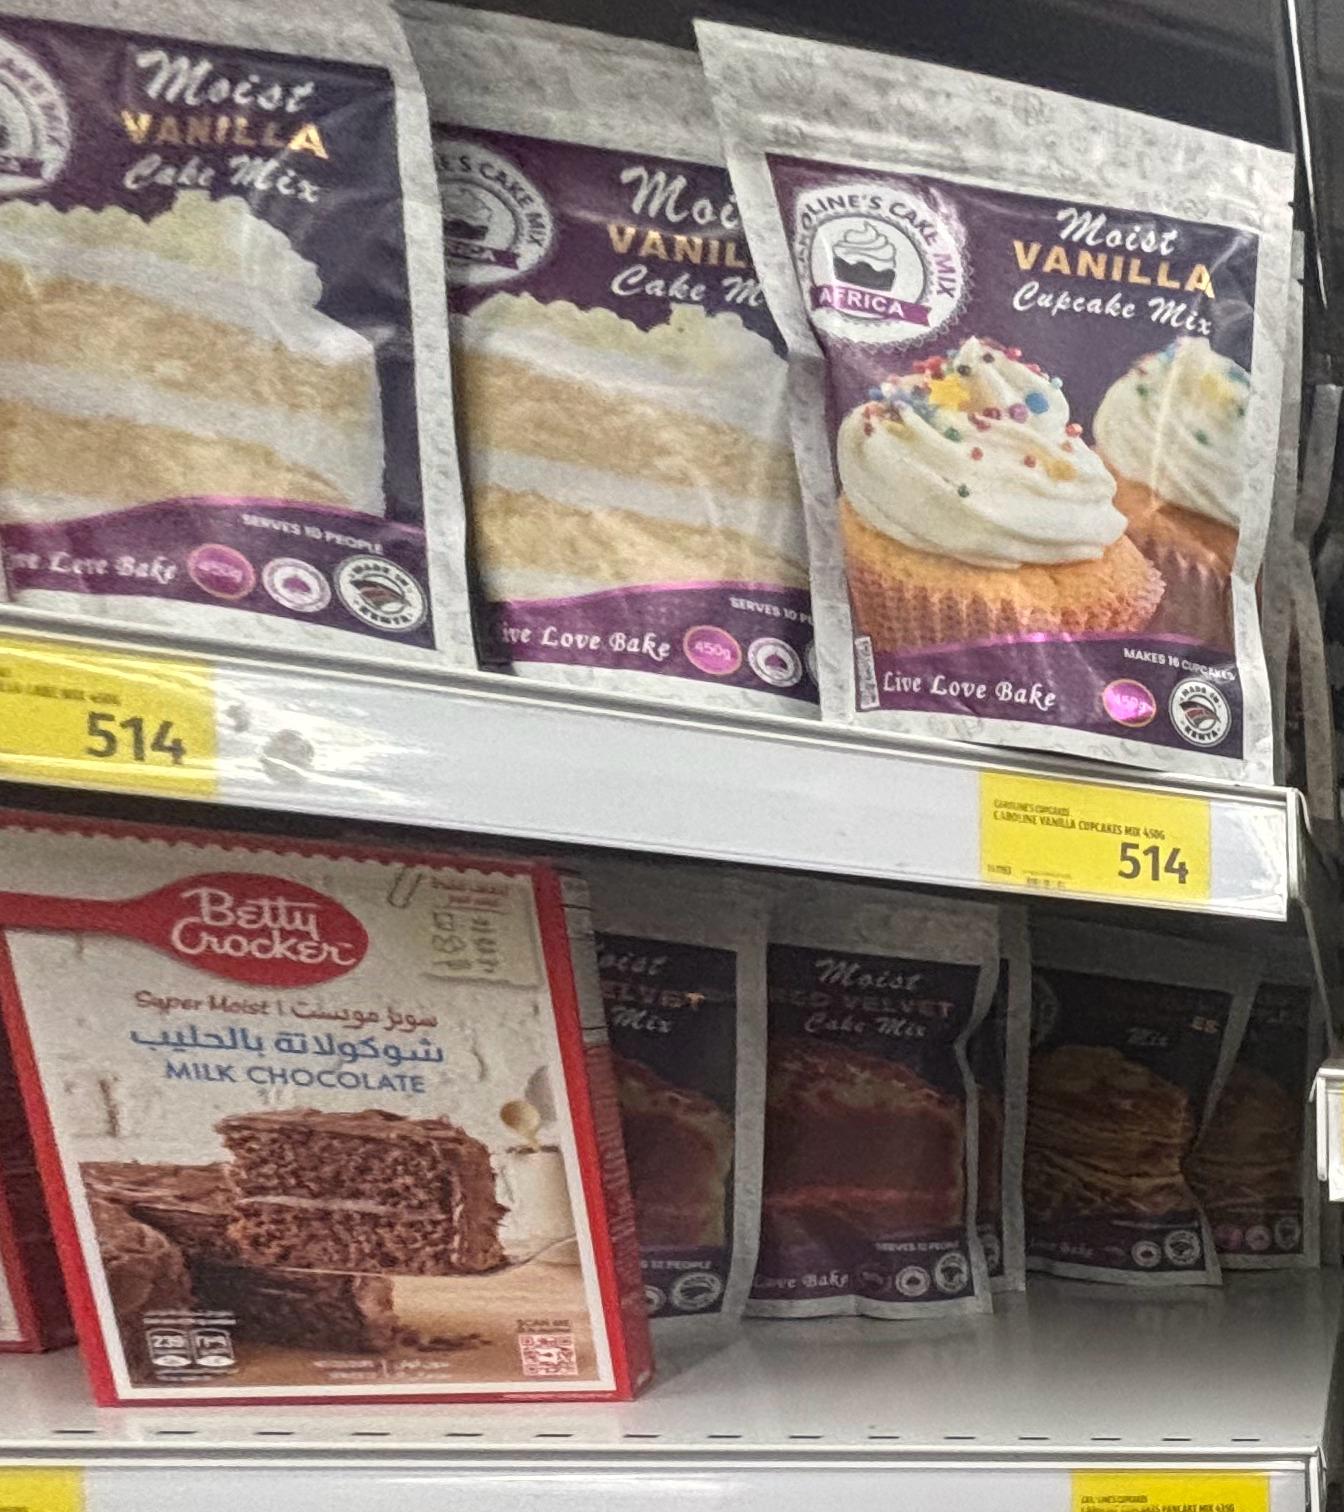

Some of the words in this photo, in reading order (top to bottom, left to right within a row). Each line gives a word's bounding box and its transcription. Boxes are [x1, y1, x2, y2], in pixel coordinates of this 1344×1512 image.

[136, 48, 314, 113] Moist
[121, 109, 329, 160] VANILLA
[124, 153, 215, 191] Cake
[230, 157, 320, 203] Mix
[606, 225, 753, 269] VANIL
[1055, 206, 1178, 258] Moist
[930, 250, 956, 298] MIX
[1011, 240, 1216, 300] VANILLA
[818, 286, 906, 319] AFRICA
[1012, 280, 1138, 322] Cupcake
[1148, 296, 1213, 337] Mix
[540, 627, 600, 653] Love
[609, 630, 671, 662] Bake
[1124, 647, 1166, 666] MAKES
[883, 670, 922, 696] Live
[931, 675, 987, 702] Love
[995, 678, 1056, 711] Bake
[85, 712, 187, 766] 514
[1118, 842, 1189, 884] 514
[182, 888, 318, 938] Betty
[171, 918, 357, 967] Crocker
[135, 991, 205, 1018] Super
[210, 995, 271, 1016] Moist
[130, 1026, 263, 1052] بالحليب
[165, 1061, 235, 1086] MILK
[246, 1065, 426, 1094] CHOCOLATE
